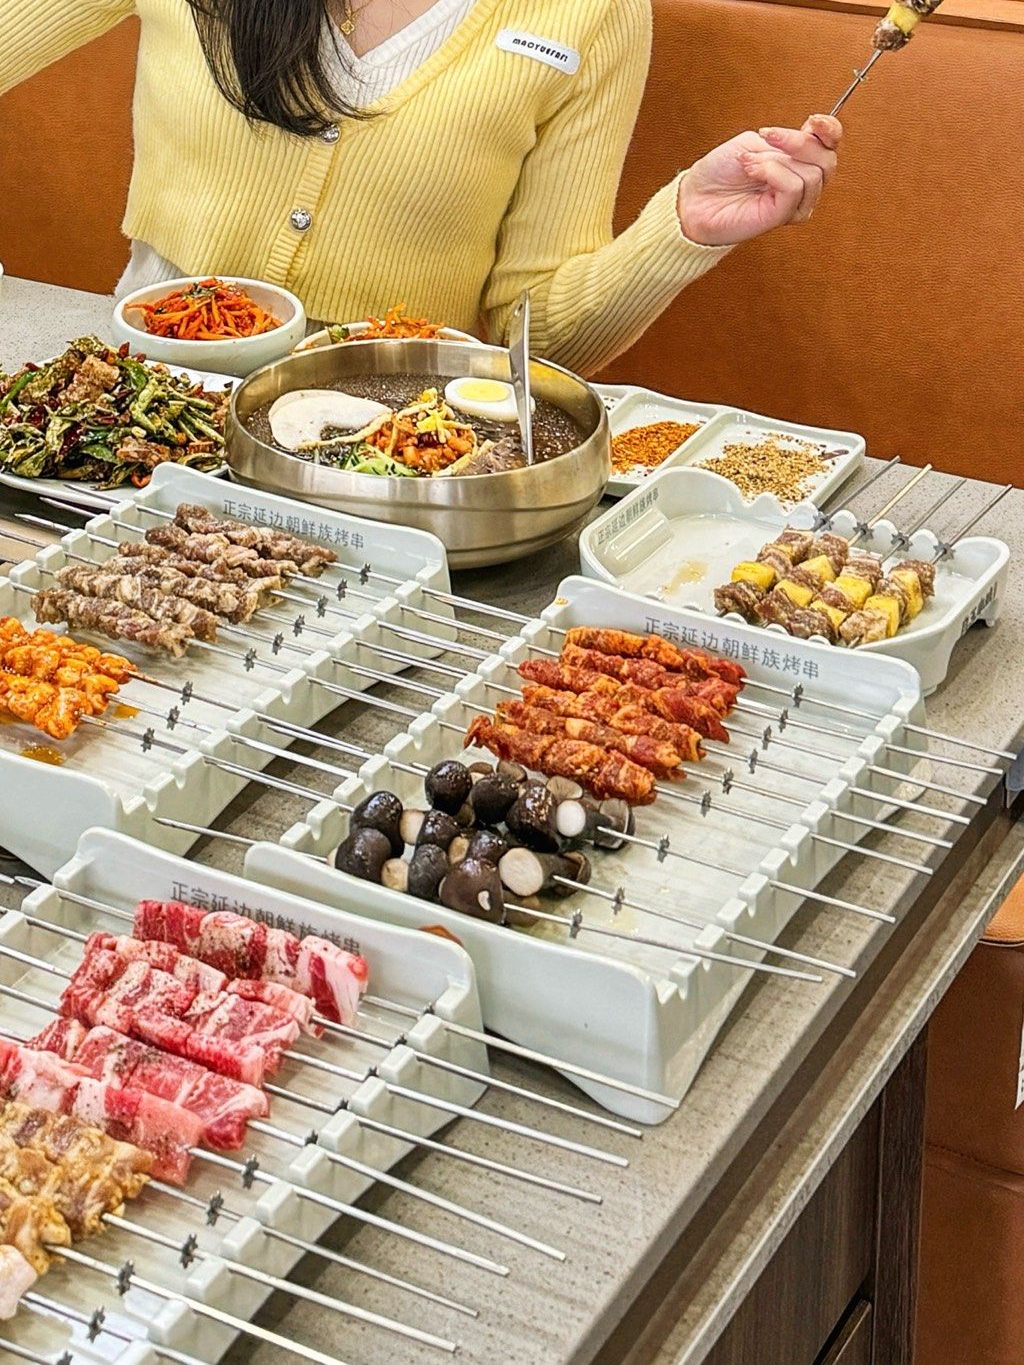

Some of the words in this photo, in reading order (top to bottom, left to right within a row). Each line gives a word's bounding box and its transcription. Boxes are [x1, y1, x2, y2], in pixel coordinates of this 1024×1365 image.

[223, 499, 366, 551] 正宗延边朝鲜族烤串
[645, 616, 820, 680] 正宗延边朝鲜族烤串
